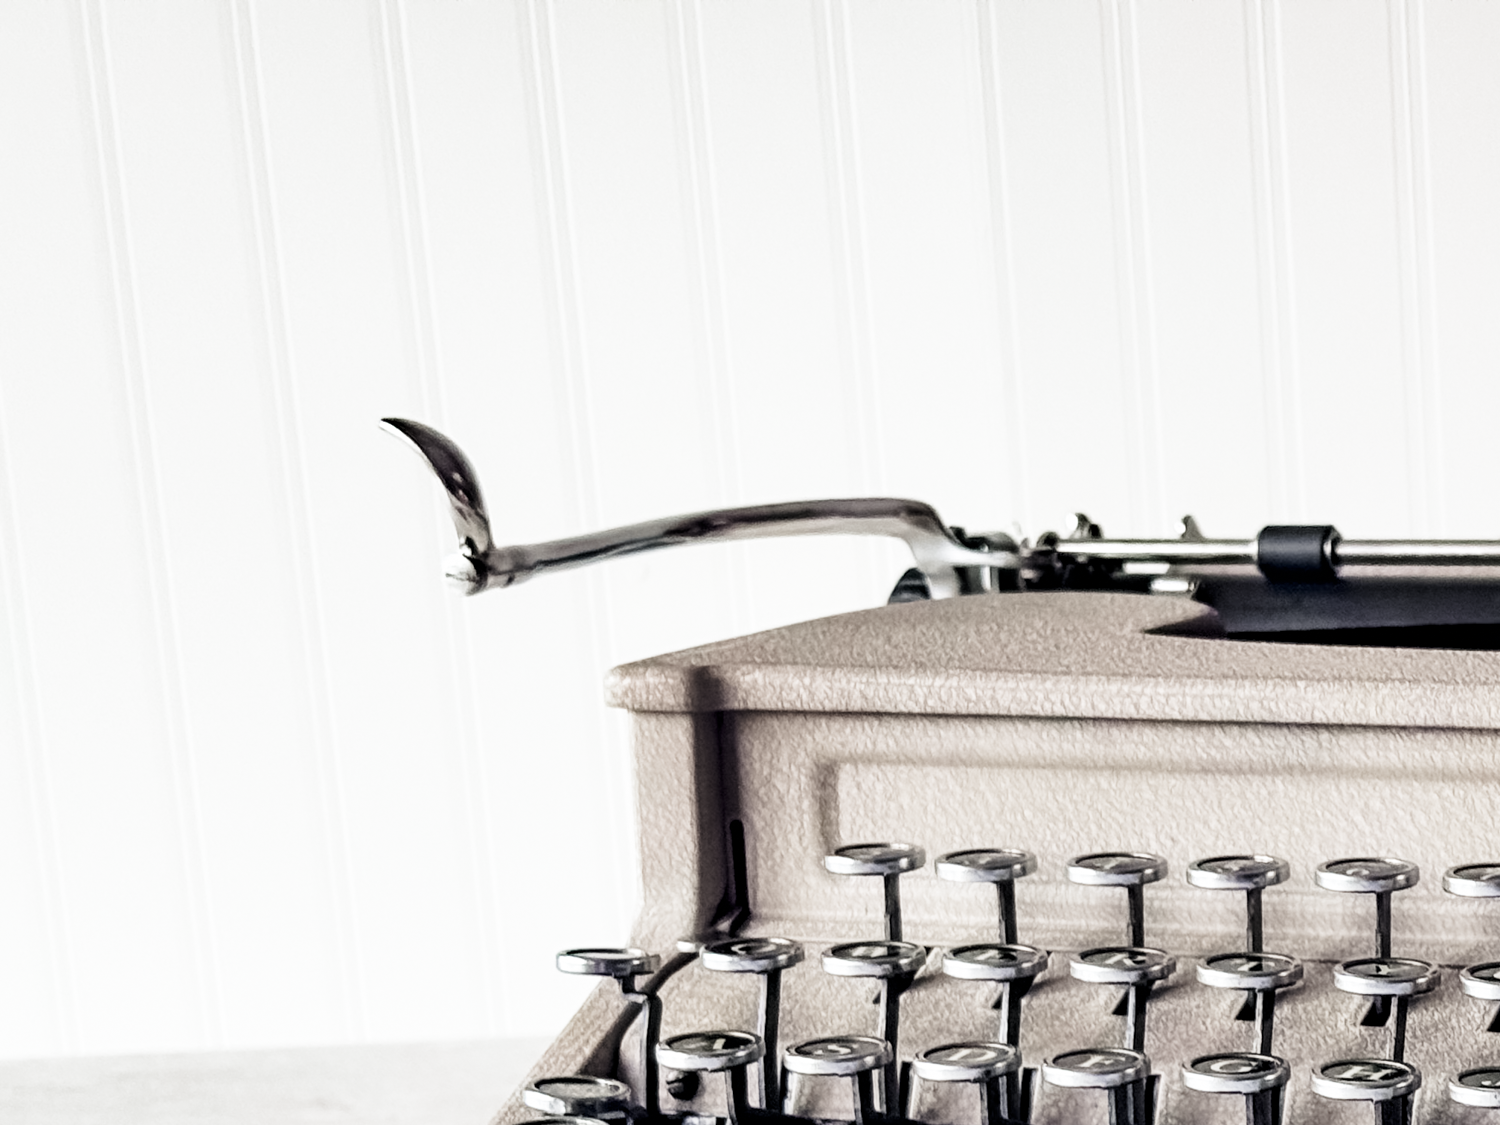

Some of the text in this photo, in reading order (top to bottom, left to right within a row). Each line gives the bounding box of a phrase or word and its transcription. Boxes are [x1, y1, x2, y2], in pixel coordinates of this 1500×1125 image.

[947, 1050, 999, 1062] D
[1078, 1056, 1129, 1068] F
[1209, 1062, 1260, 1074] G
[1335, 1066, 1392, 1081] H
